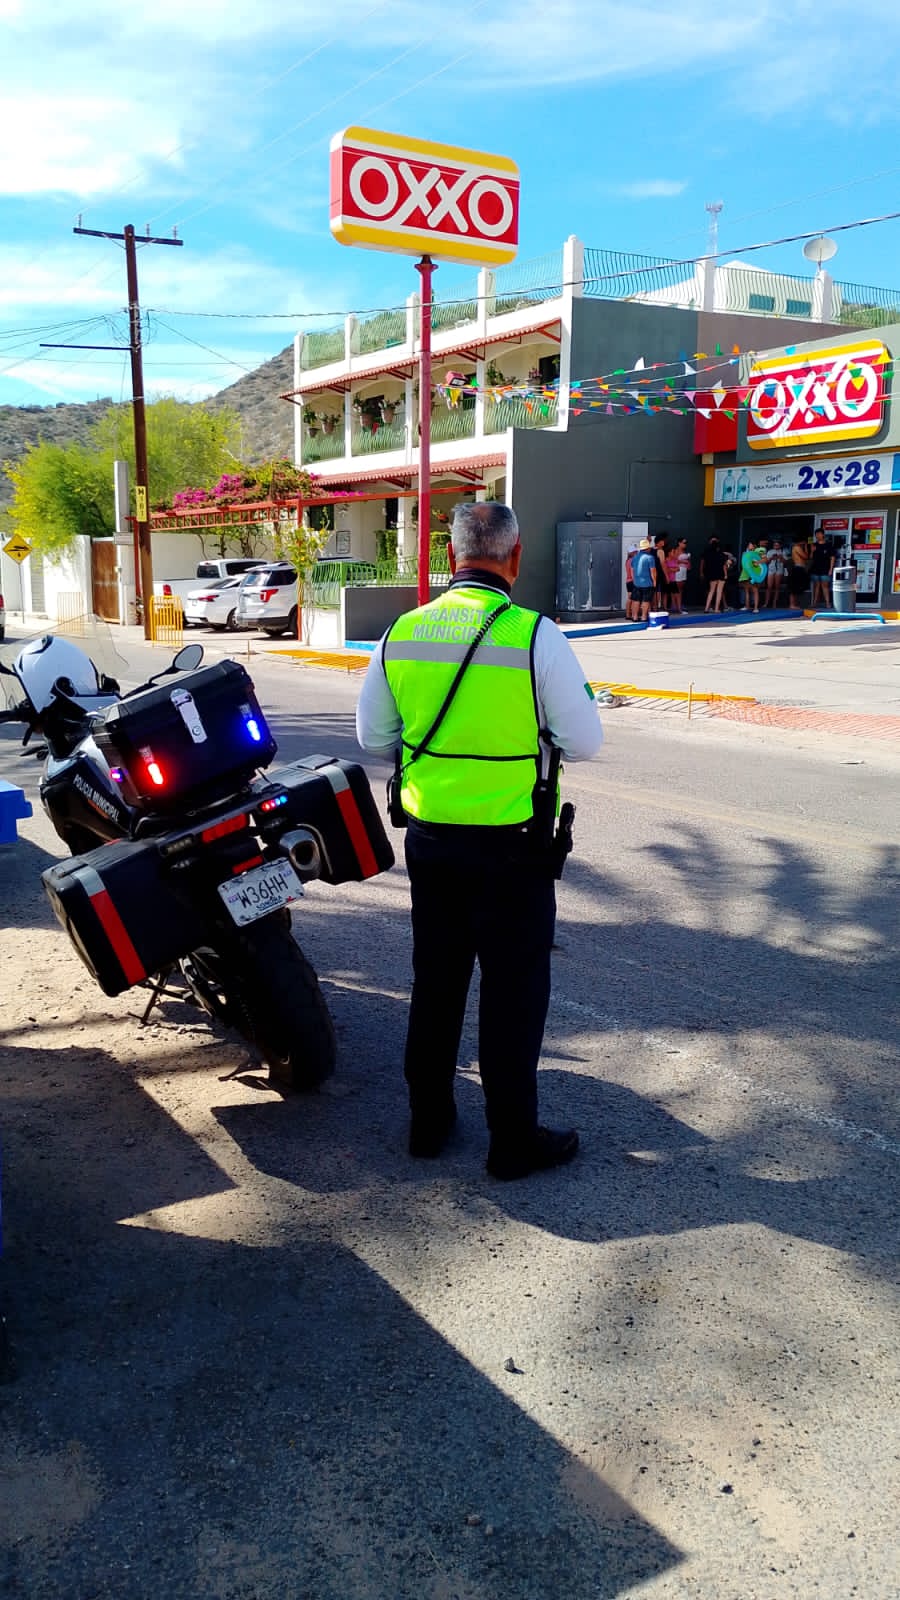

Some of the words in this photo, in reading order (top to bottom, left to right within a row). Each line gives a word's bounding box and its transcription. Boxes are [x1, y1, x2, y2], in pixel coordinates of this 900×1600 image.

[350, 156, 513, 237] OXXO
[751, 360, 878, 430] OXXO
[412, 623, 496, 645] MUNICIPL
[237, 873, 289, 909] W36HH
